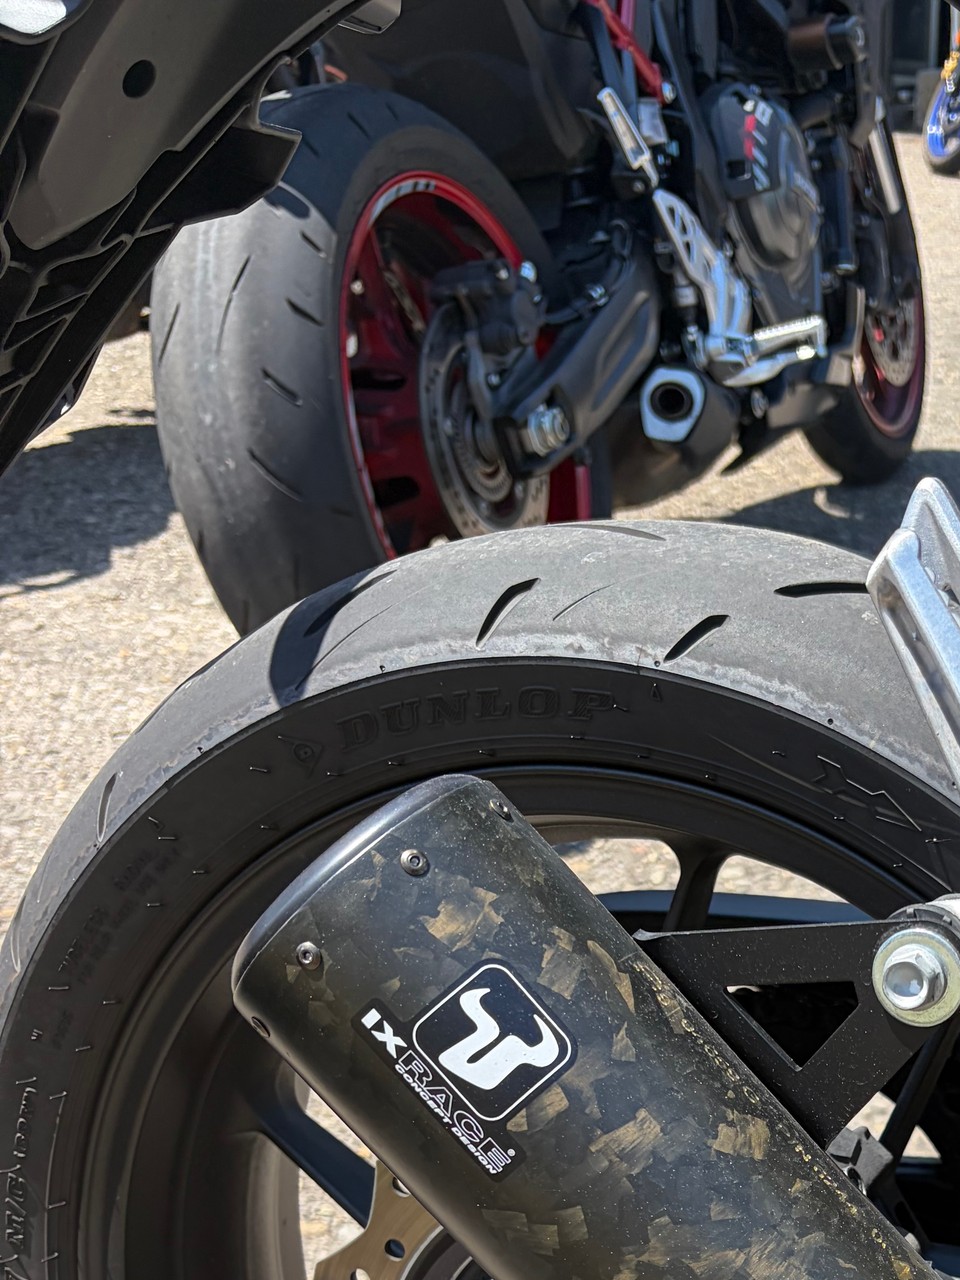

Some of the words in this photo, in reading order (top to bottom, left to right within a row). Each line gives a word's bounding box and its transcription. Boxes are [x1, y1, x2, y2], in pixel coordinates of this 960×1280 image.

[335, 684, 616, 753] DUNLOP
[394, 1064, 453, 1125] CONCEPT
[451, 1126, 498, 1175] DESIGN
